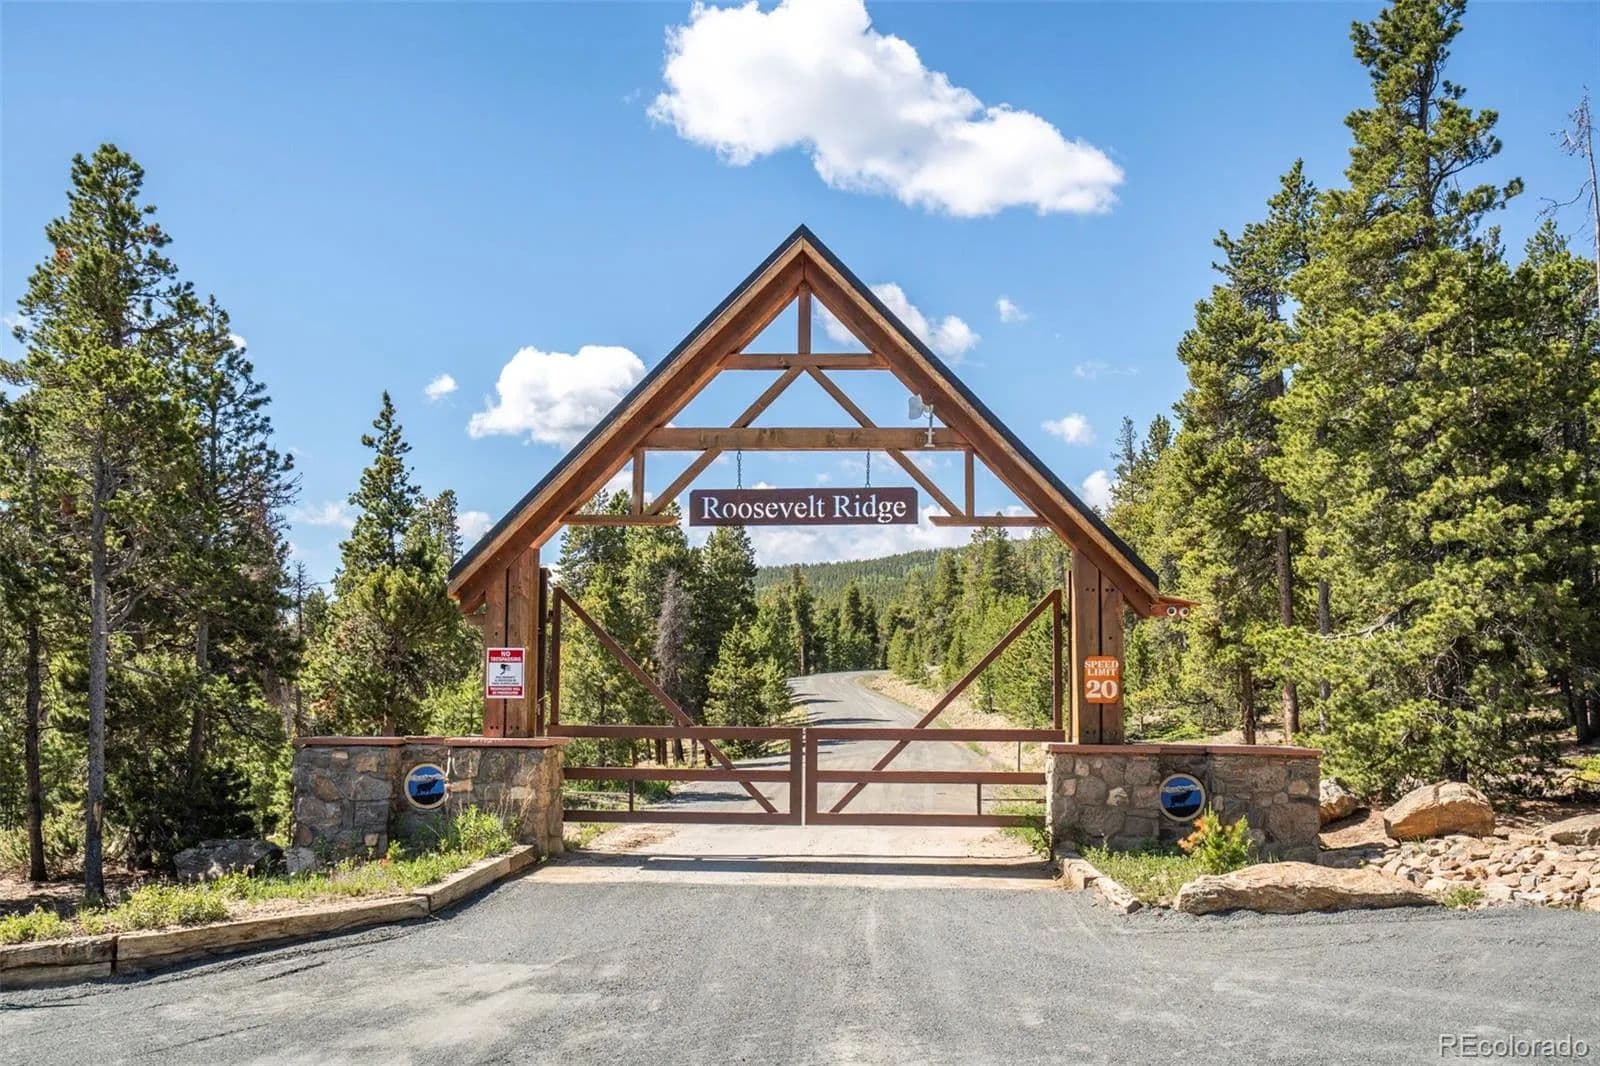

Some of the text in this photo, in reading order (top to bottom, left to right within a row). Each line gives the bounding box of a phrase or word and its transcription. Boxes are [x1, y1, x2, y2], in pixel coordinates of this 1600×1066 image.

[701, 494, 907, 523] Roosevelt Ridge
[1084, 660, 1119, 669] SPEED
[1087, 668, 1116, 676] LIMIT
[1086, 680, 1118, 699] 20
